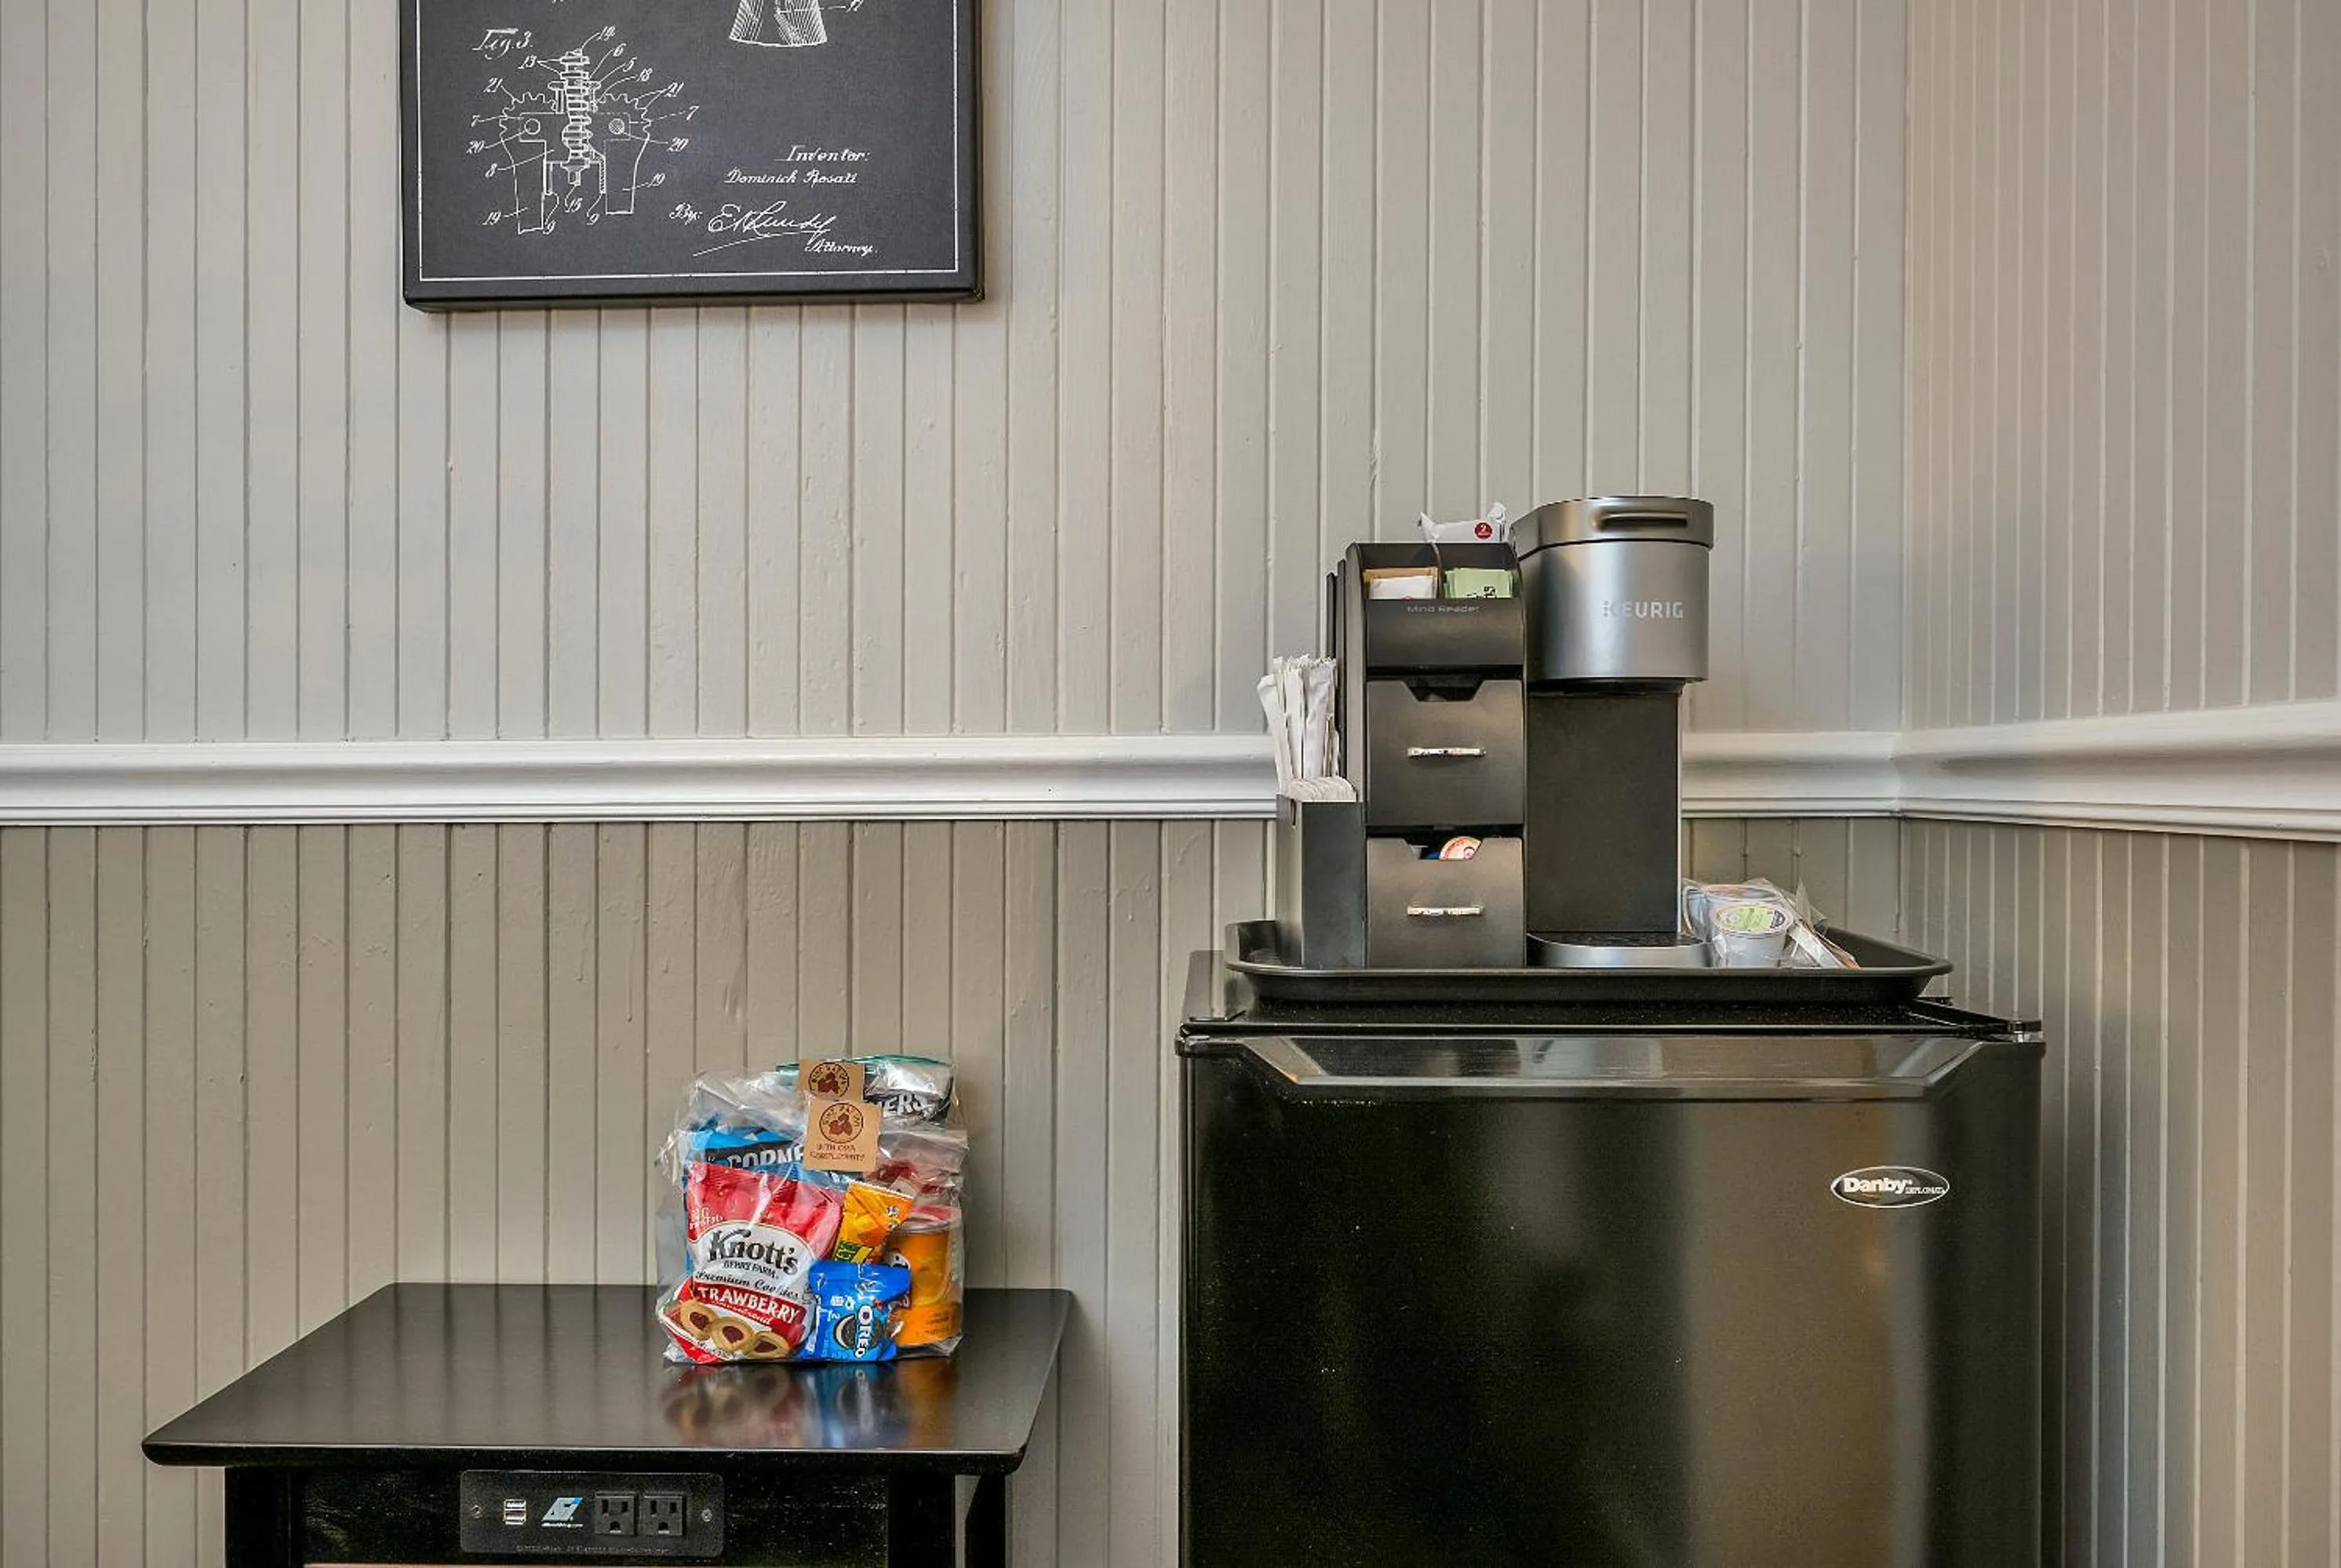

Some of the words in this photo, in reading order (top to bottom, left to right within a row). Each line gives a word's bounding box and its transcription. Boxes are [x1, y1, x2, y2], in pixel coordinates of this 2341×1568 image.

[613, 42, 627, 57] 6
[518, 54, 537, 69] 13
[686, 105, 700, 120] 7
[1603, 600, 1684, 619] KEURIG
[879, 1091, 931, 1118] ERS
[1844, 1177, 1910, 1195] Danby
[707, 1228, 799, 1275] Knott's
[697, 1286, 800, 1324] TRAWBERRY
[854, 1304, 873, 1359] OREO
